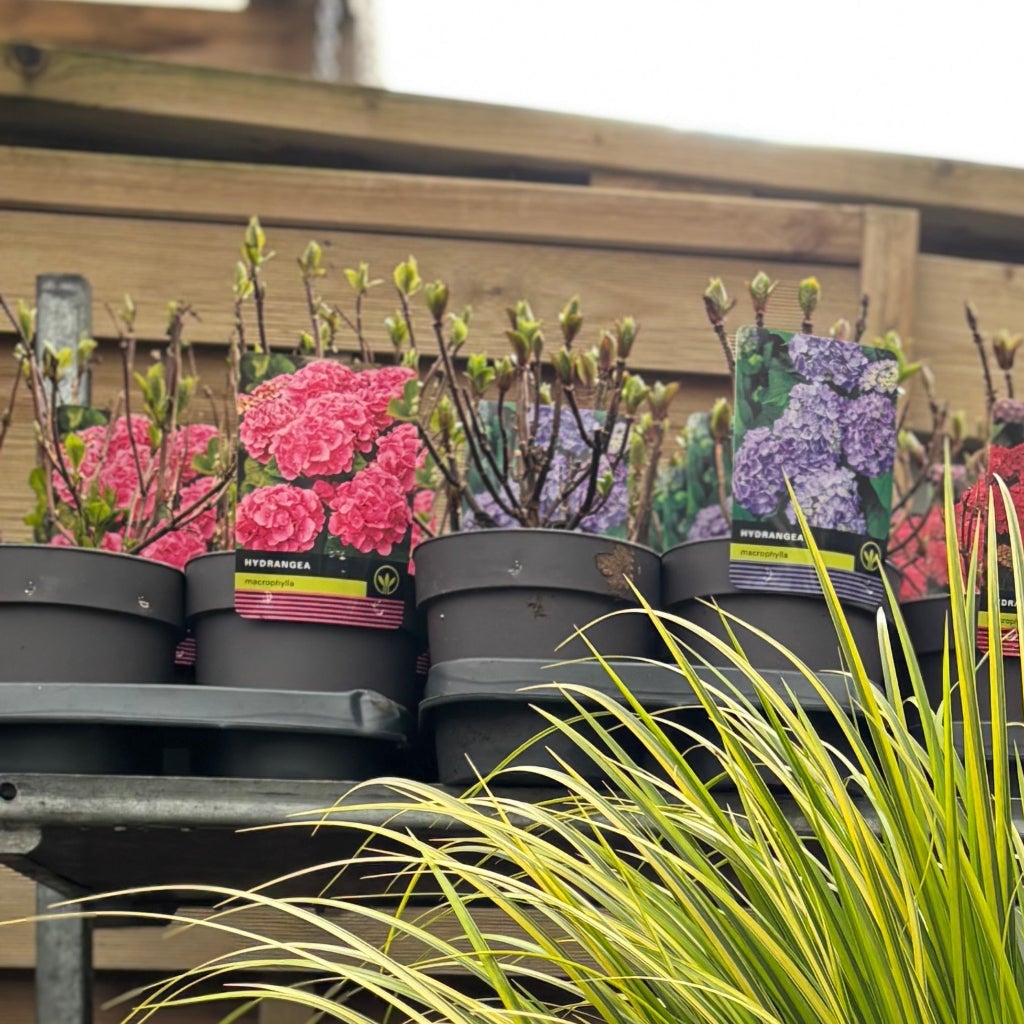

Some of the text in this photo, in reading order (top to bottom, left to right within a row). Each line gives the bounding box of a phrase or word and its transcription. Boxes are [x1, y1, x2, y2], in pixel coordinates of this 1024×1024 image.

[740, 529, 804, 541] HYDRANGEA
[740, 549, 788, 560] macrophylla
[244, 558, 311, 570] HYDRANGEA
[244, 577, 295, 589] macrophylla
